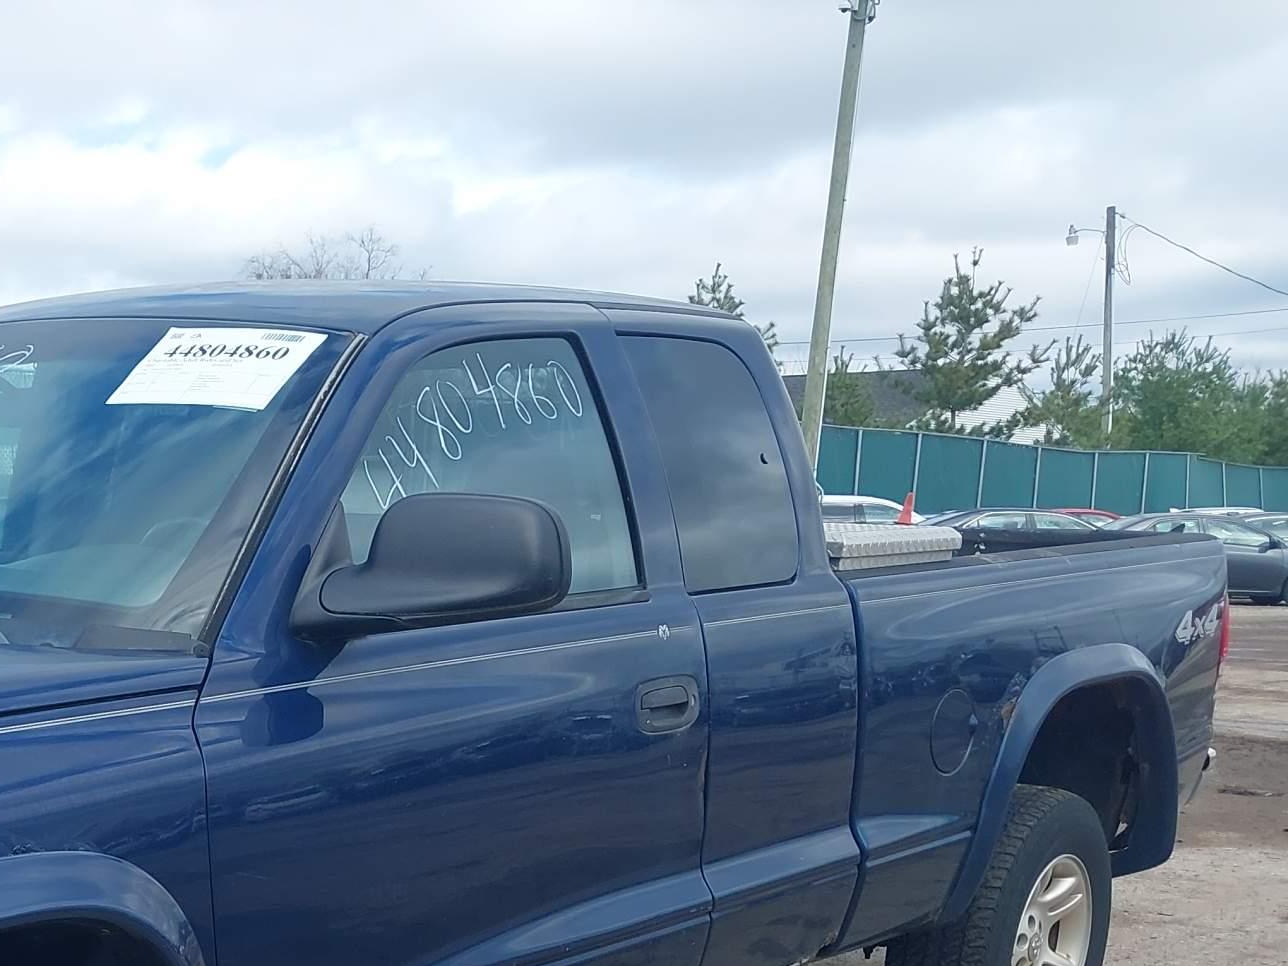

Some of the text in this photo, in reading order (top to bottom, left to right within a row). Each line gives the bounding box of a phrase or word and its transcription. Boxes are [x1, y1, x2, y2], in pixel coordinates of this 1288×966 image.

[163, 343, 291, 361] 44804860
[363, 352, 583, 510] 44804860
[1174, 603, 1221, 646] 4x4
